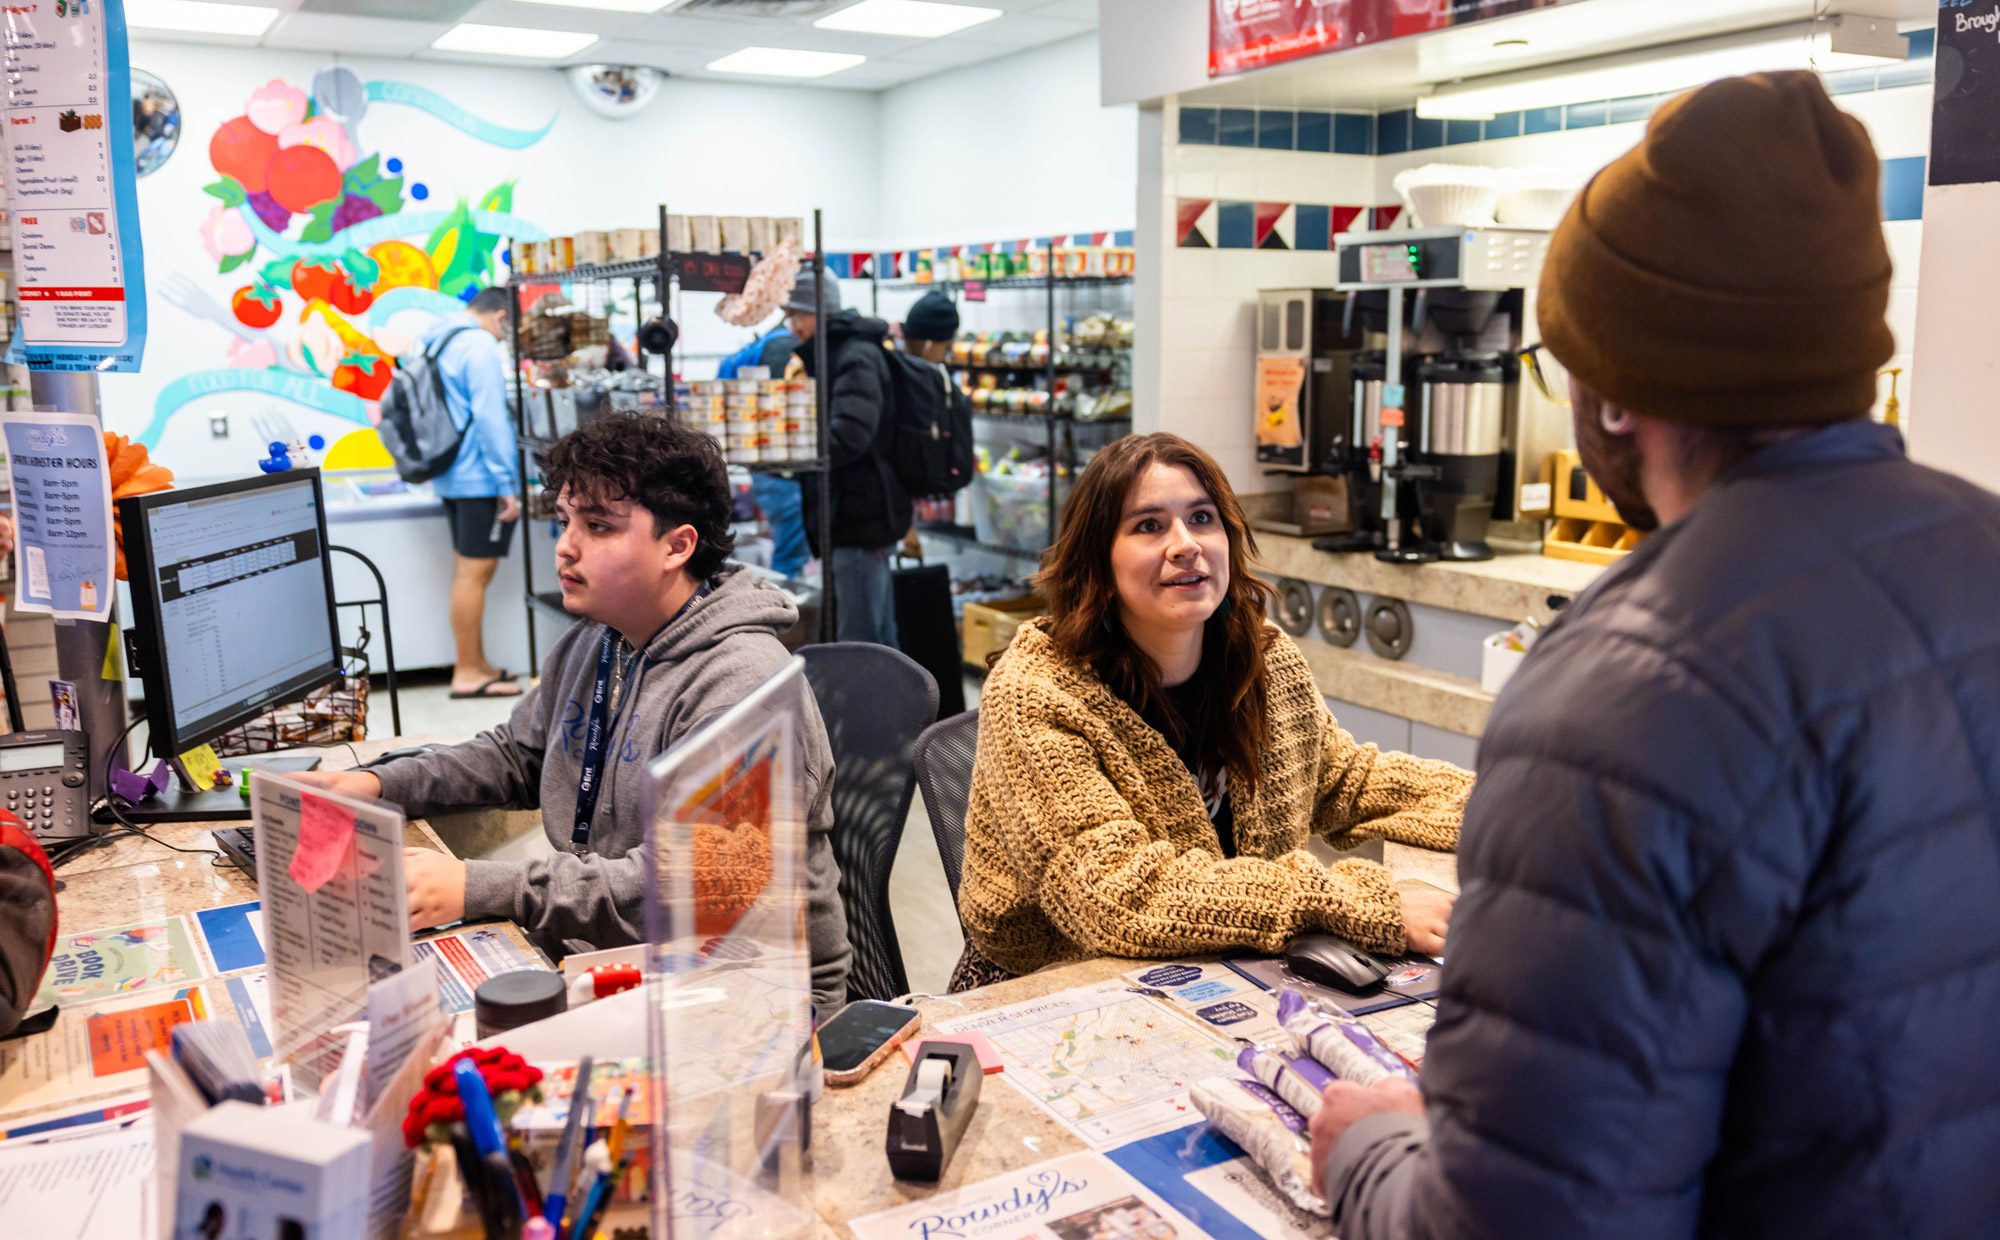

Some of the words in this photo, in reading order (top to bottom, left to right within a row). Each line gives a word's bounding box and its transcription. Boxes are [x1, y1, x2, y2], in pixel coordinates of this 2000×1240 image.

[20, 217, 38, 225] FREE
[53, 953, 78, 987] DRIVE
[76, 949, 104, 980] BOOK
[1009, 1001, 1071, 1019] SERVICES
[909, 1170, 1088, 1240] Rowdy's
[972, 1212, 1033, 1236] CORNER
